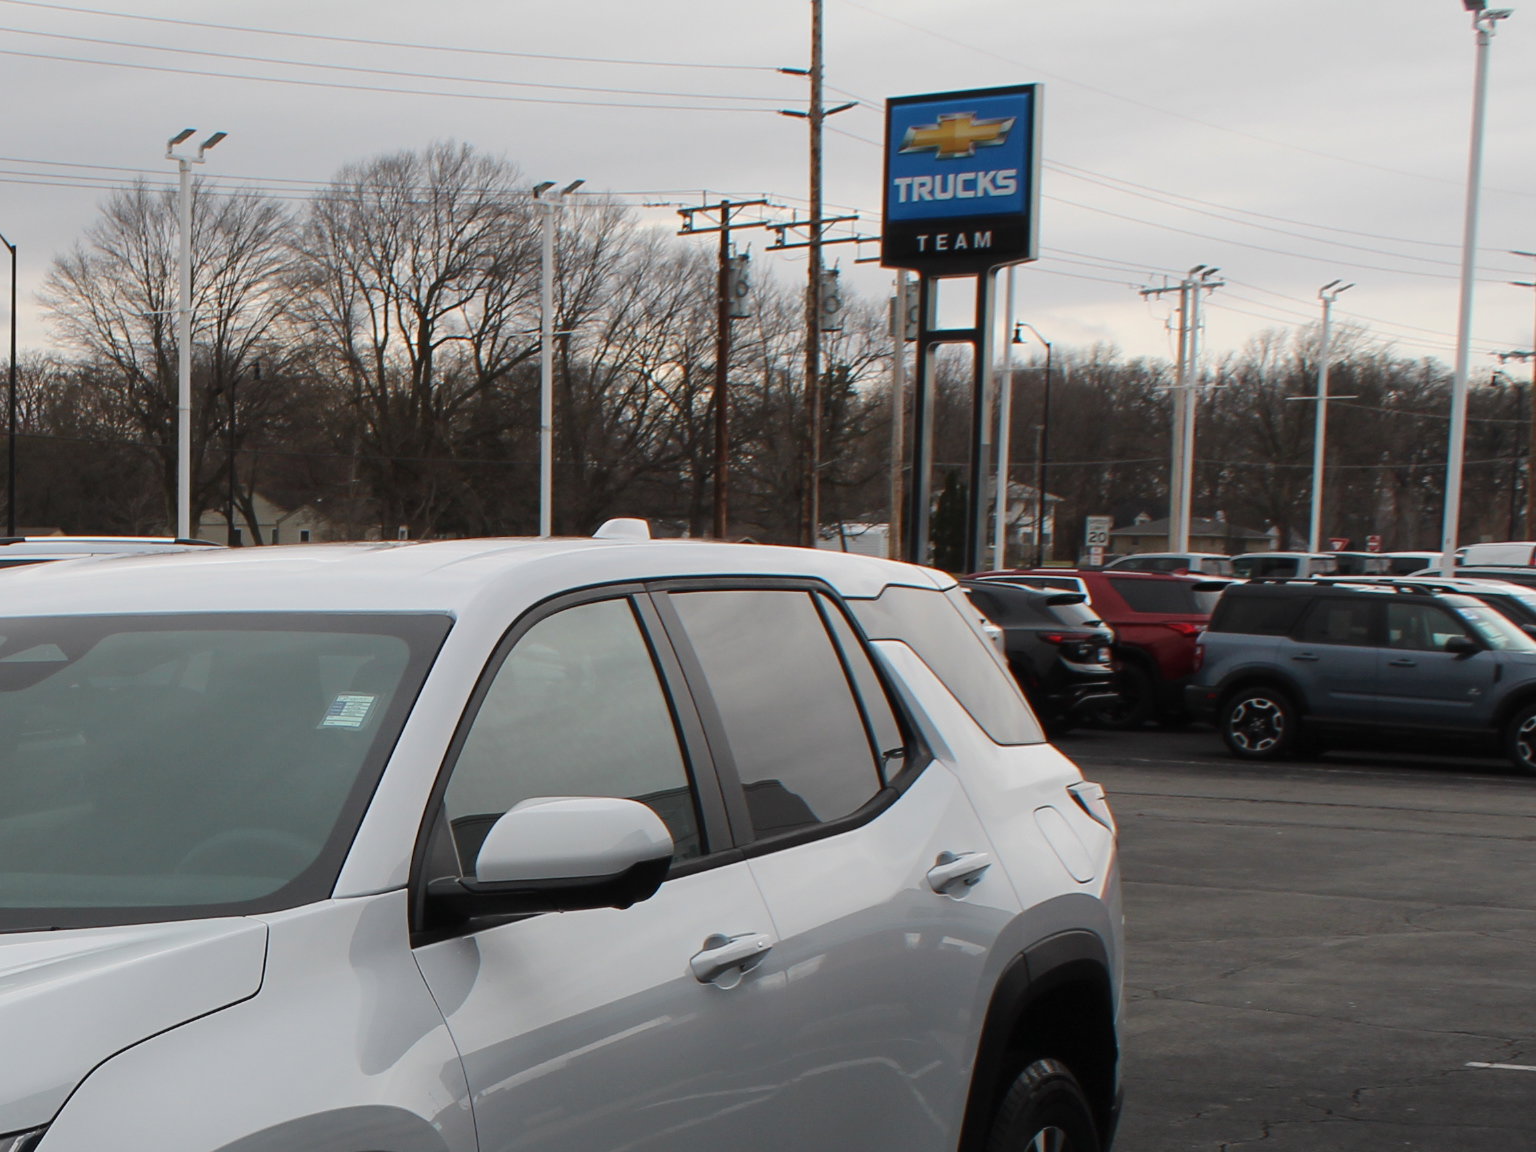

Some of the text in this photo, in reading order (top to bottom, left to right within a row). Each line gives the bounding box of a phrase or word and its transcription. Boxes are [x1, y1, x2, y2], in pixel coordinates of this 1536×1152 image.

[894, 169, 1018, 203] TRUCKS
[916, 230, 992, 252] TEAM
[1088, 531, 1106, 543] 20
